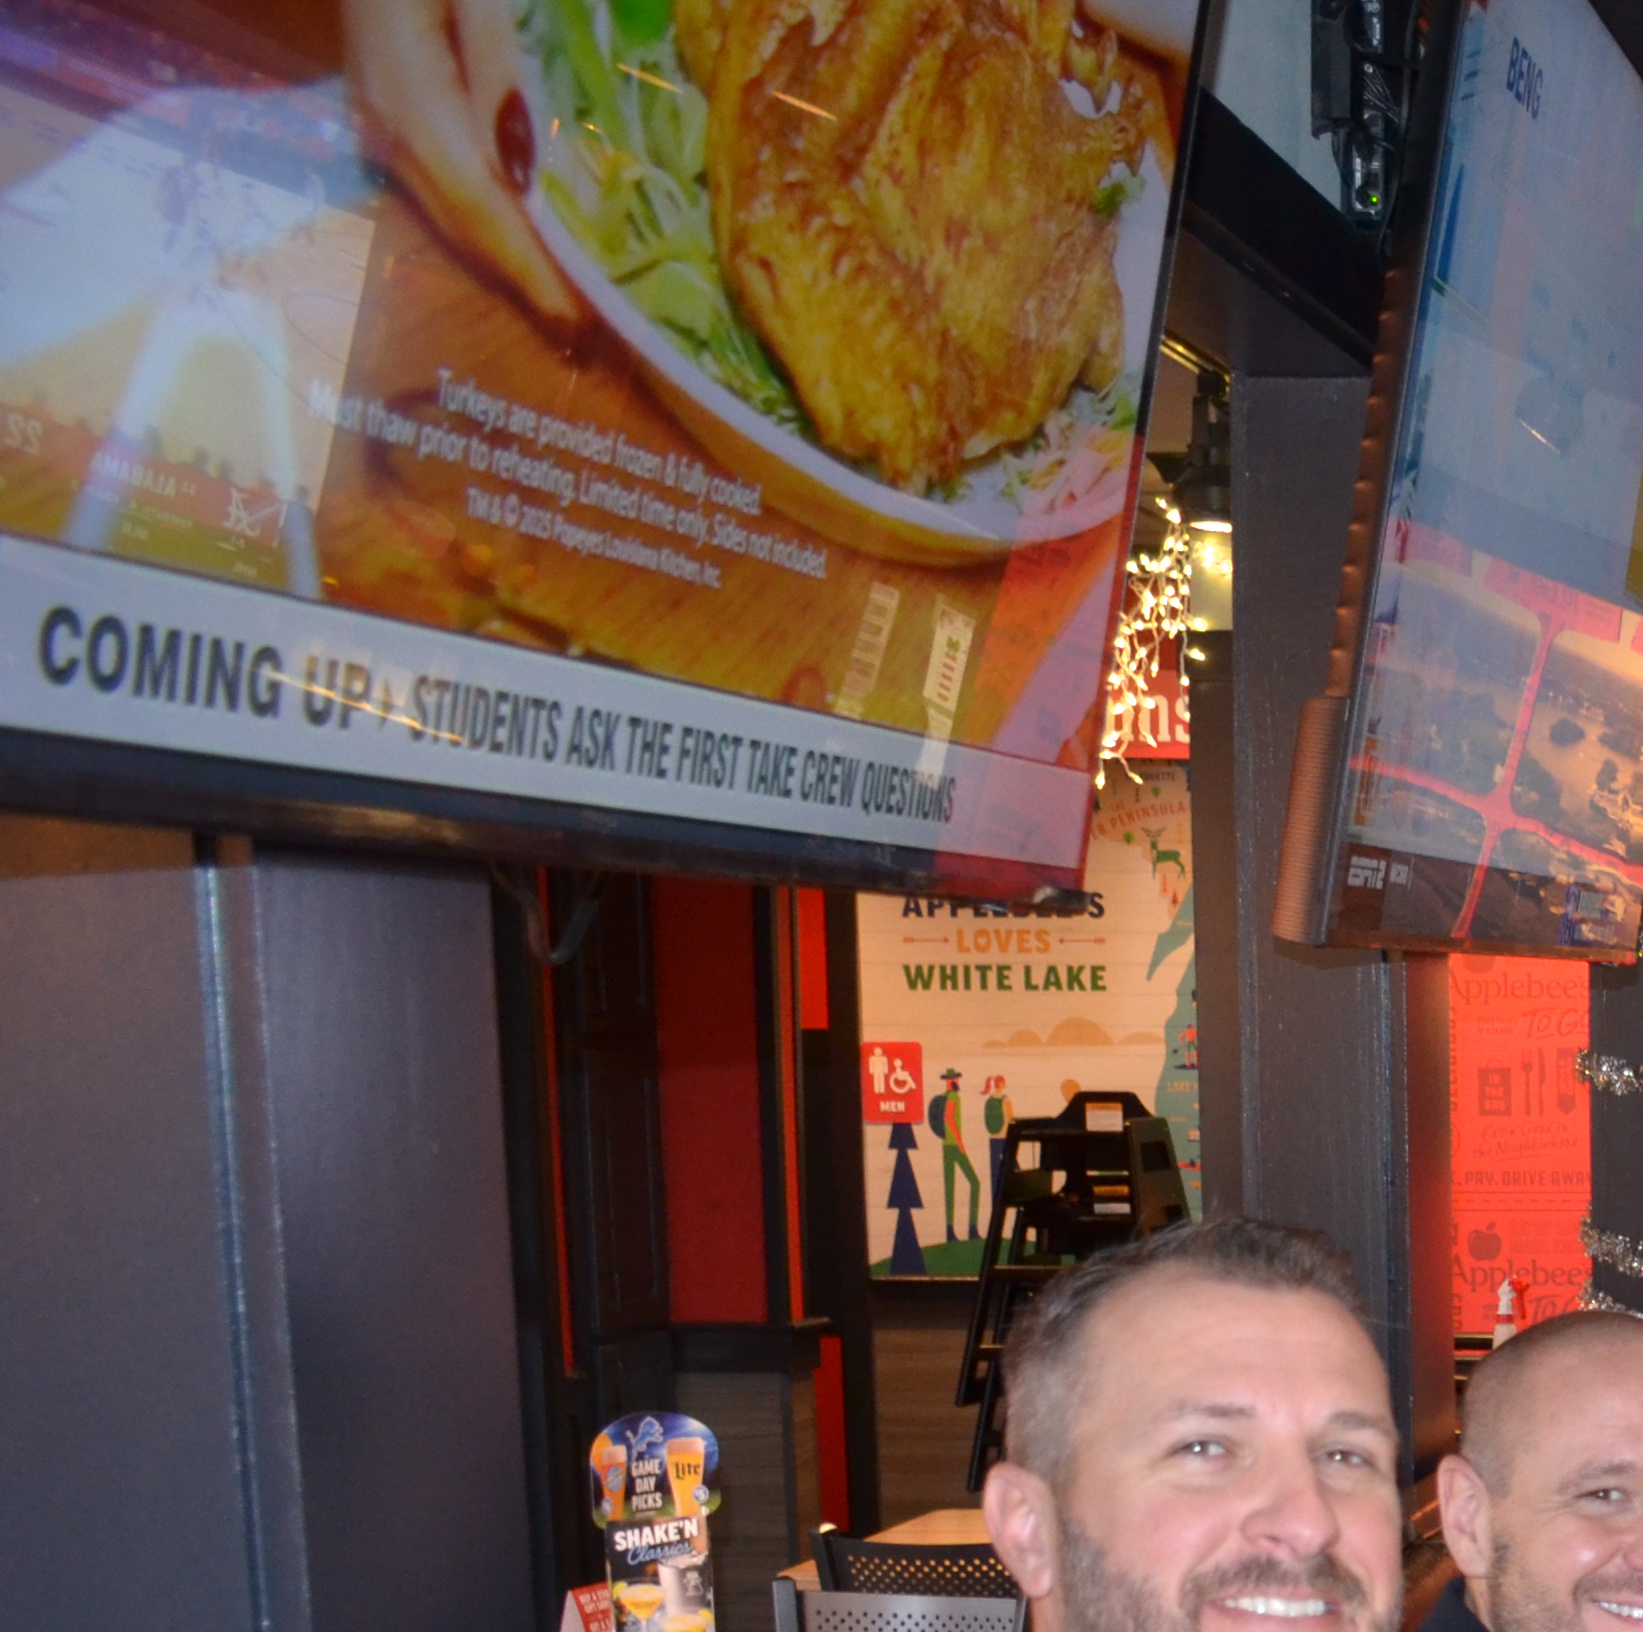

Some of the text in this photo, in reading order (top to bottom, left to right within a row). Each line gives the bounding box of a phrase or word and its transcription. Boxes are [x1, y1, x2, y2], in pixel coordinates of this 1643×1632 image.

[436, 367, 505, 431] Turkeys
[508, 406, 536, 436] are
[538, 415, 613, 467] provided
[613, 445, 663, 482] frozen
[678, 458, 709, 502] fully
[366, 403, 415, 445] thaw
[417, 421, 467, 463] prior
[469, 437, 489, 470] to
[579, 471, 638, 521] Limited
[640, 485, 674, 531] time
[710, 510, 746, 556] Sides
[38, 606, 957, 825] COMING UP STUDENTS ASK THE FIRST TAKE CREW QUESTIONS
[1110, 801, 1186, 829] PENINSULA
[956, 929, 1053, 954] LOVES
[904, 964, 1107, 991] WHITE LAKE
[880, 1101, 905, 1113] MEN
[630, 1459, 662, 1477] GAME
[673, 1461, 702, 1481] Lite
[635, 1476, 657, 1494] DAY
[631, 1493, 662, 1511] PICKS
[614, 1518, 700, 1552] SHAKE'N
